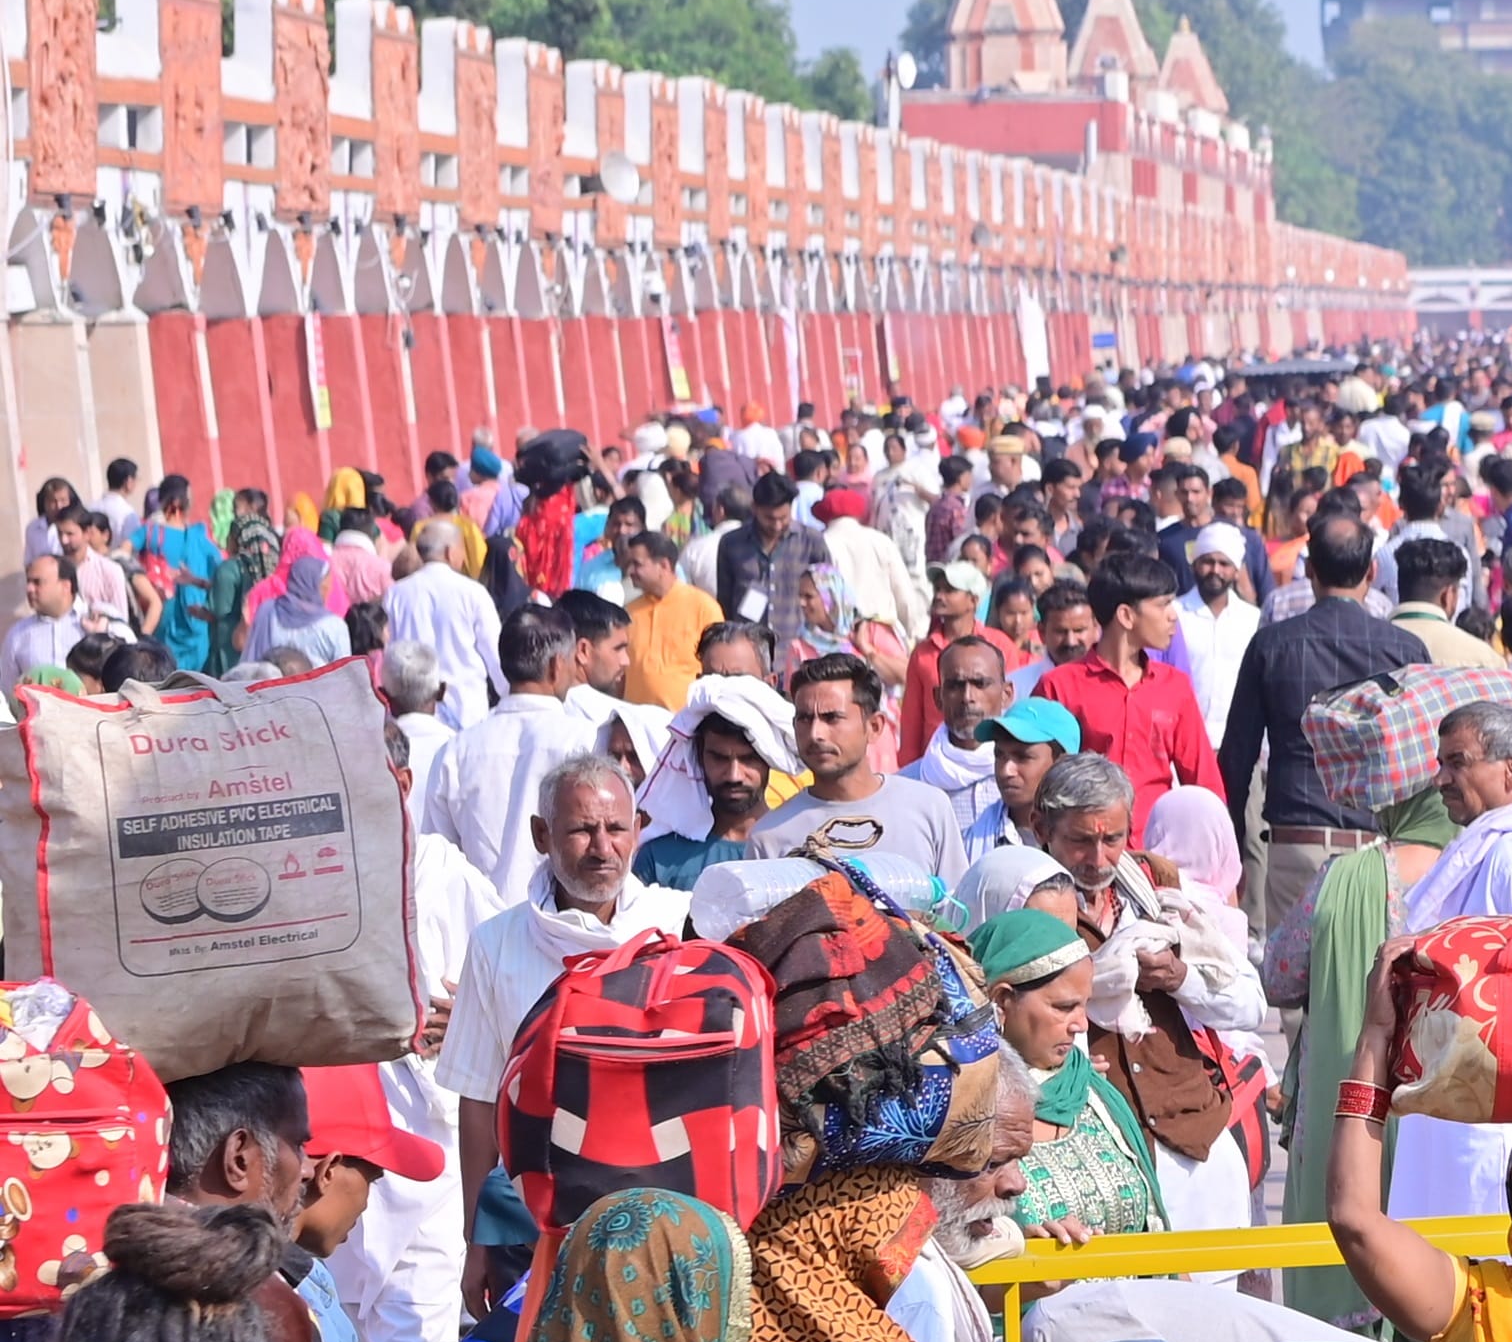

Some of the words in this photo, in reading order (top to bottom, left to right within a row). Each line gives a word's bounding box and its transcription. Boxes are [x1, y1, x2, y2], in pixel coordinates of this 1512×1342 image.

[130, 733, 209, 756] Dura
[219, 719, 292, 751] Stick
[207, 771, 293, 799] Amstel
[123, 818, 158, 835] SELF
[160, 810, 227, 830] ADHESIVE
[229, 806, 257, 824] PVC
[258, 796, 336, 819] ELECTRICAL
[177, 828, 257, 851] INSULATION
[257, 823, 292, 841] TAPE
[210, 938, 255, 951] Amstel
[259, 930, 319, 946] Electrical
